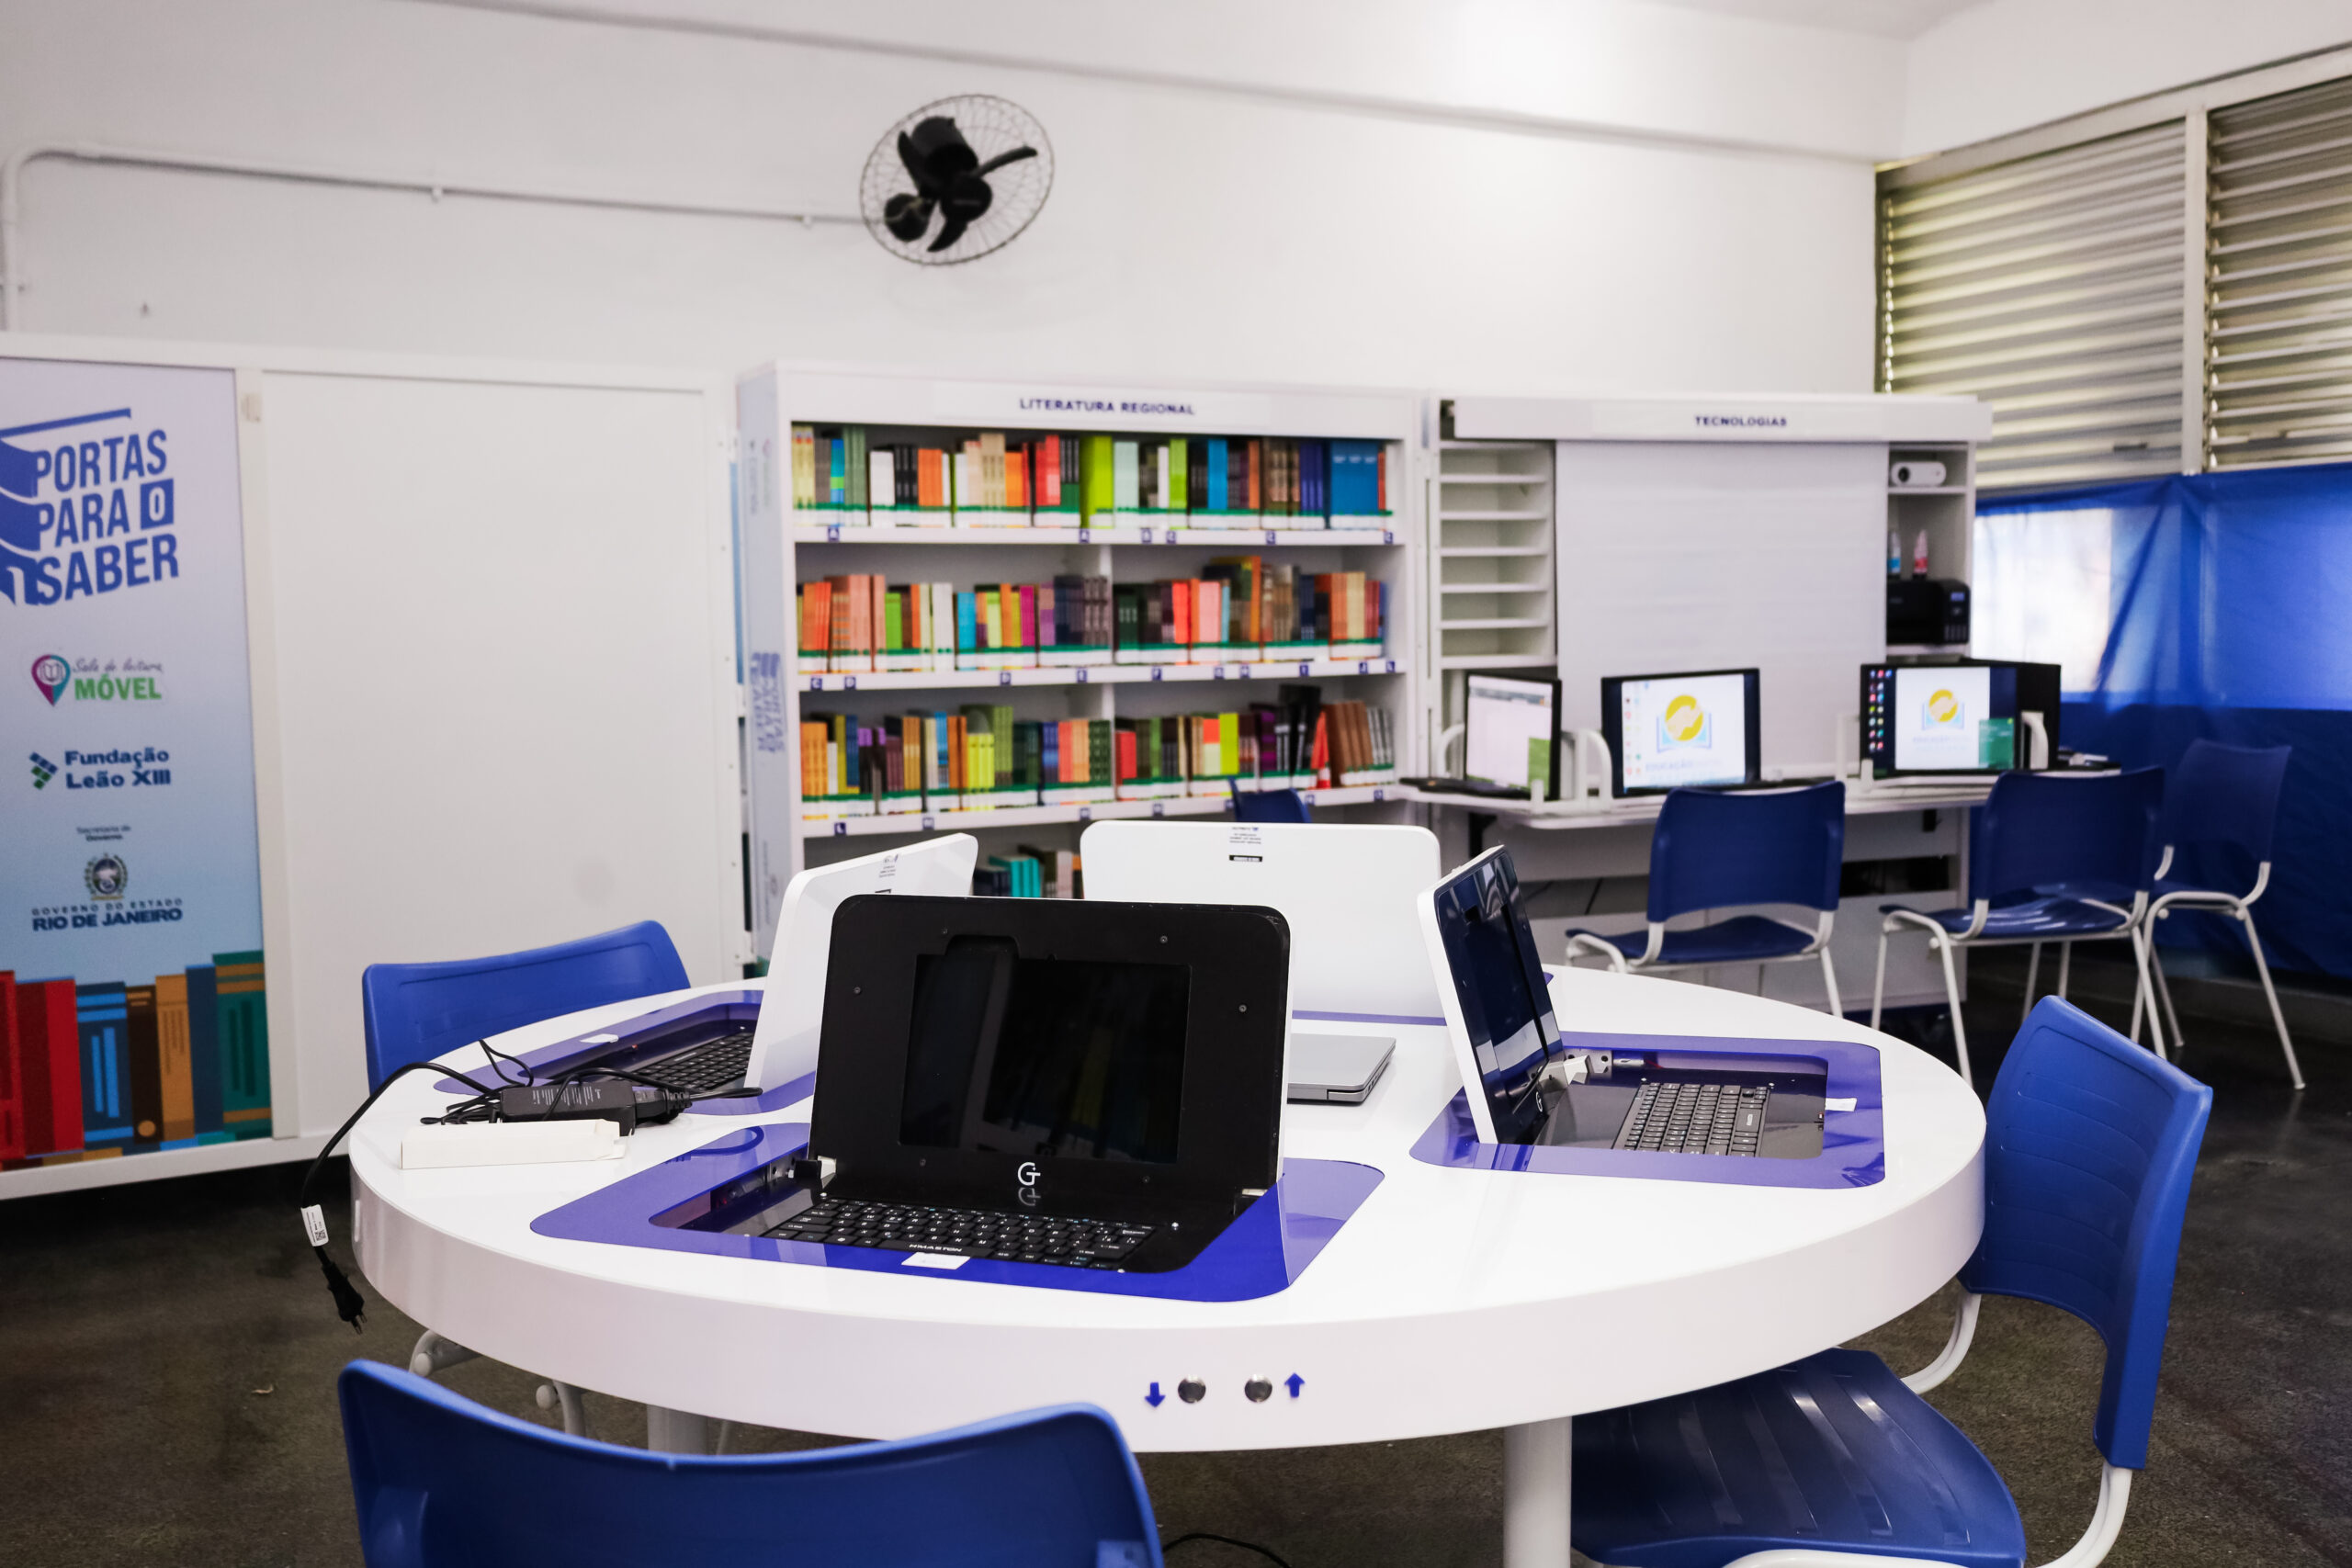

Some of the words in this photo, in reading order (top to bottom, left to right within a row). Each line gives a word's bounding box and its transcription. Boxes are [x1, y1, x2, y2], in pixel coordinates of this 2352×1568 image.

[1019, 399, 1114, 412] LITERATURA
[1120, 401, 1196, 415] REGIONAL
[1695, 415, 1788, 427] TECNOLOGIAS
[33, 429, 167, 498] PORTAS
[34, 488, 130, 551] PARA
[145, 482, 169, 525] O
[36, 533, 179, 606] SABER
[74, 672, 163, 701] MÓVEL
[64, 746, 169, 770] Fundação
[66, 770, 125, 789] Leão
[131, 769, 171, 787] XIII
[31, 904, 99, 917] GOVERNO
[105, 902, 124, 911] DO
[130, 897, 183, 909] ESTADO
[32, 915, 68, 931] RIO
[72, 913, 98, 929] DE
[102, 908, 183, 927] JANEIRO
